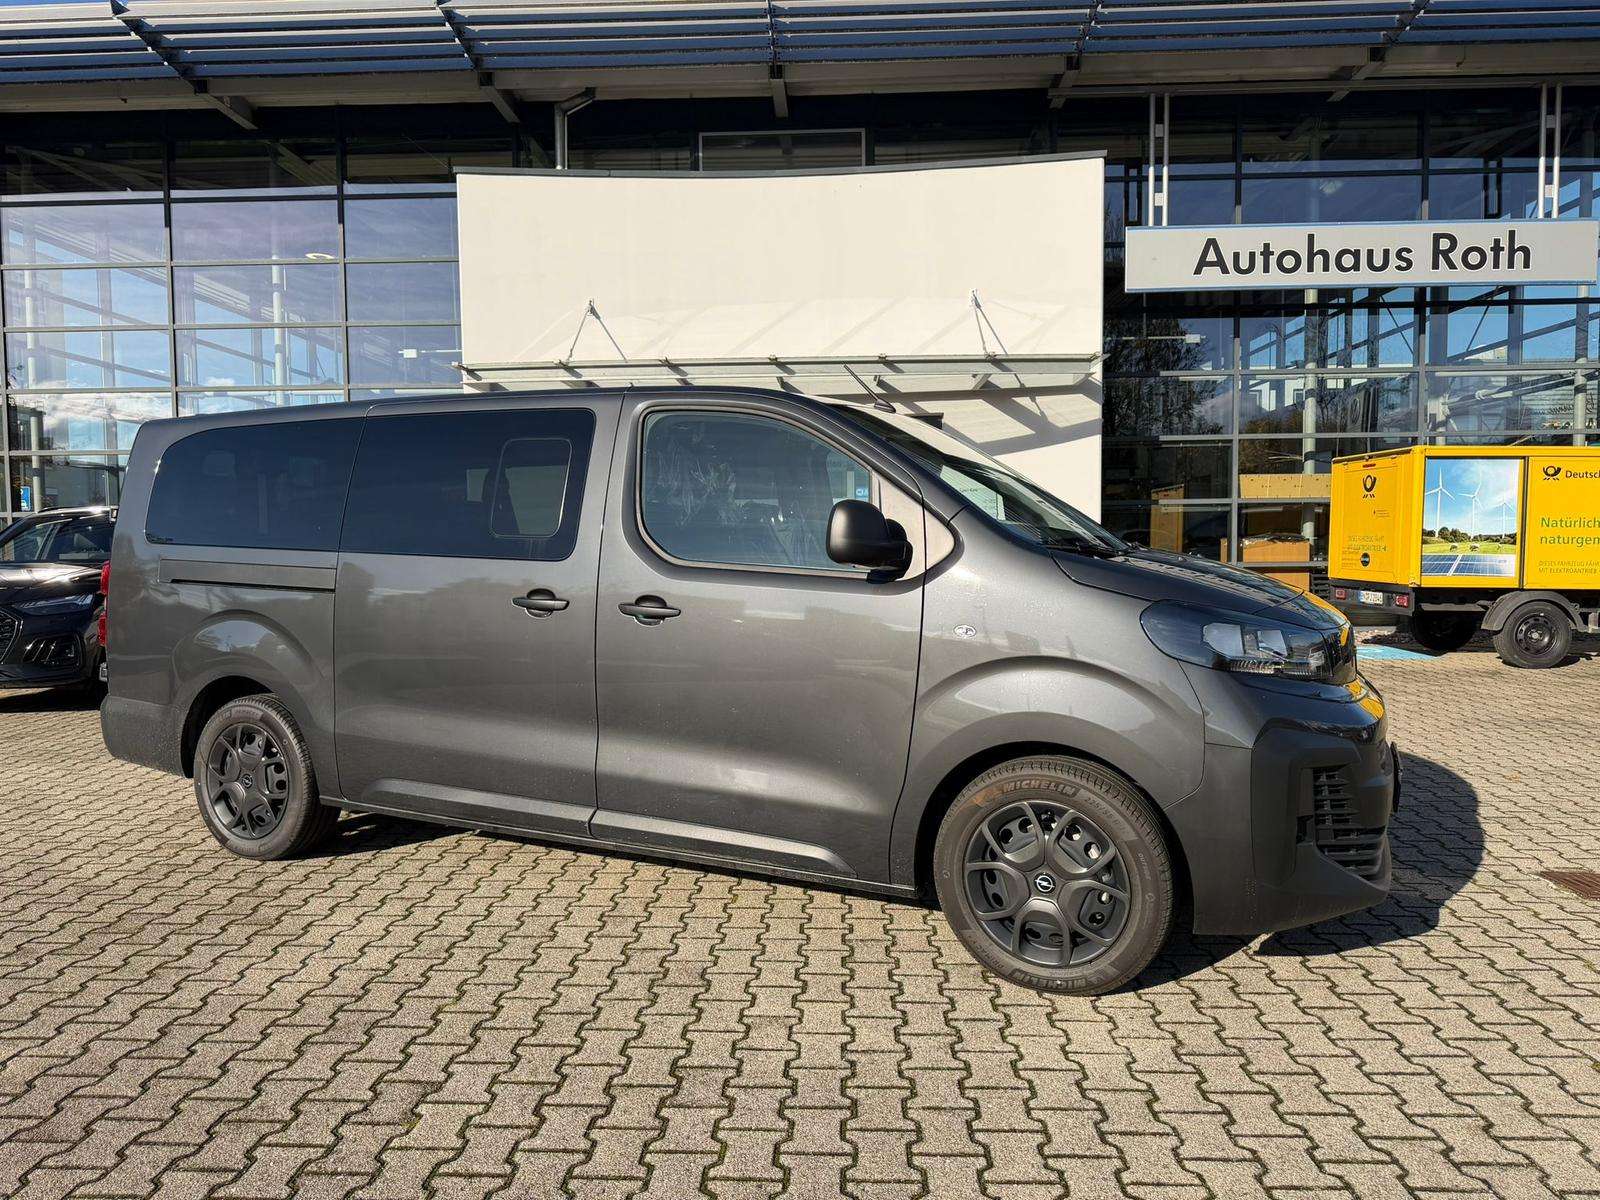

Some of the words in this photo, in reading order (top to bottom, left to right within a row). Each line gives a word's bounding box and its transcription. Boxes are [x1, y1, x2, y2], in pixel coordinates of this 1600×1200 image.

[1193, 233, 1414, 276] Autohaus
[1431, 229, 1531, 271] Roth
[1565, 470, 1600, 479] Deutsc
[1541, 516, 1600, 528] Natürlich
[1003, 780, 1077, 796] MICHELIN
